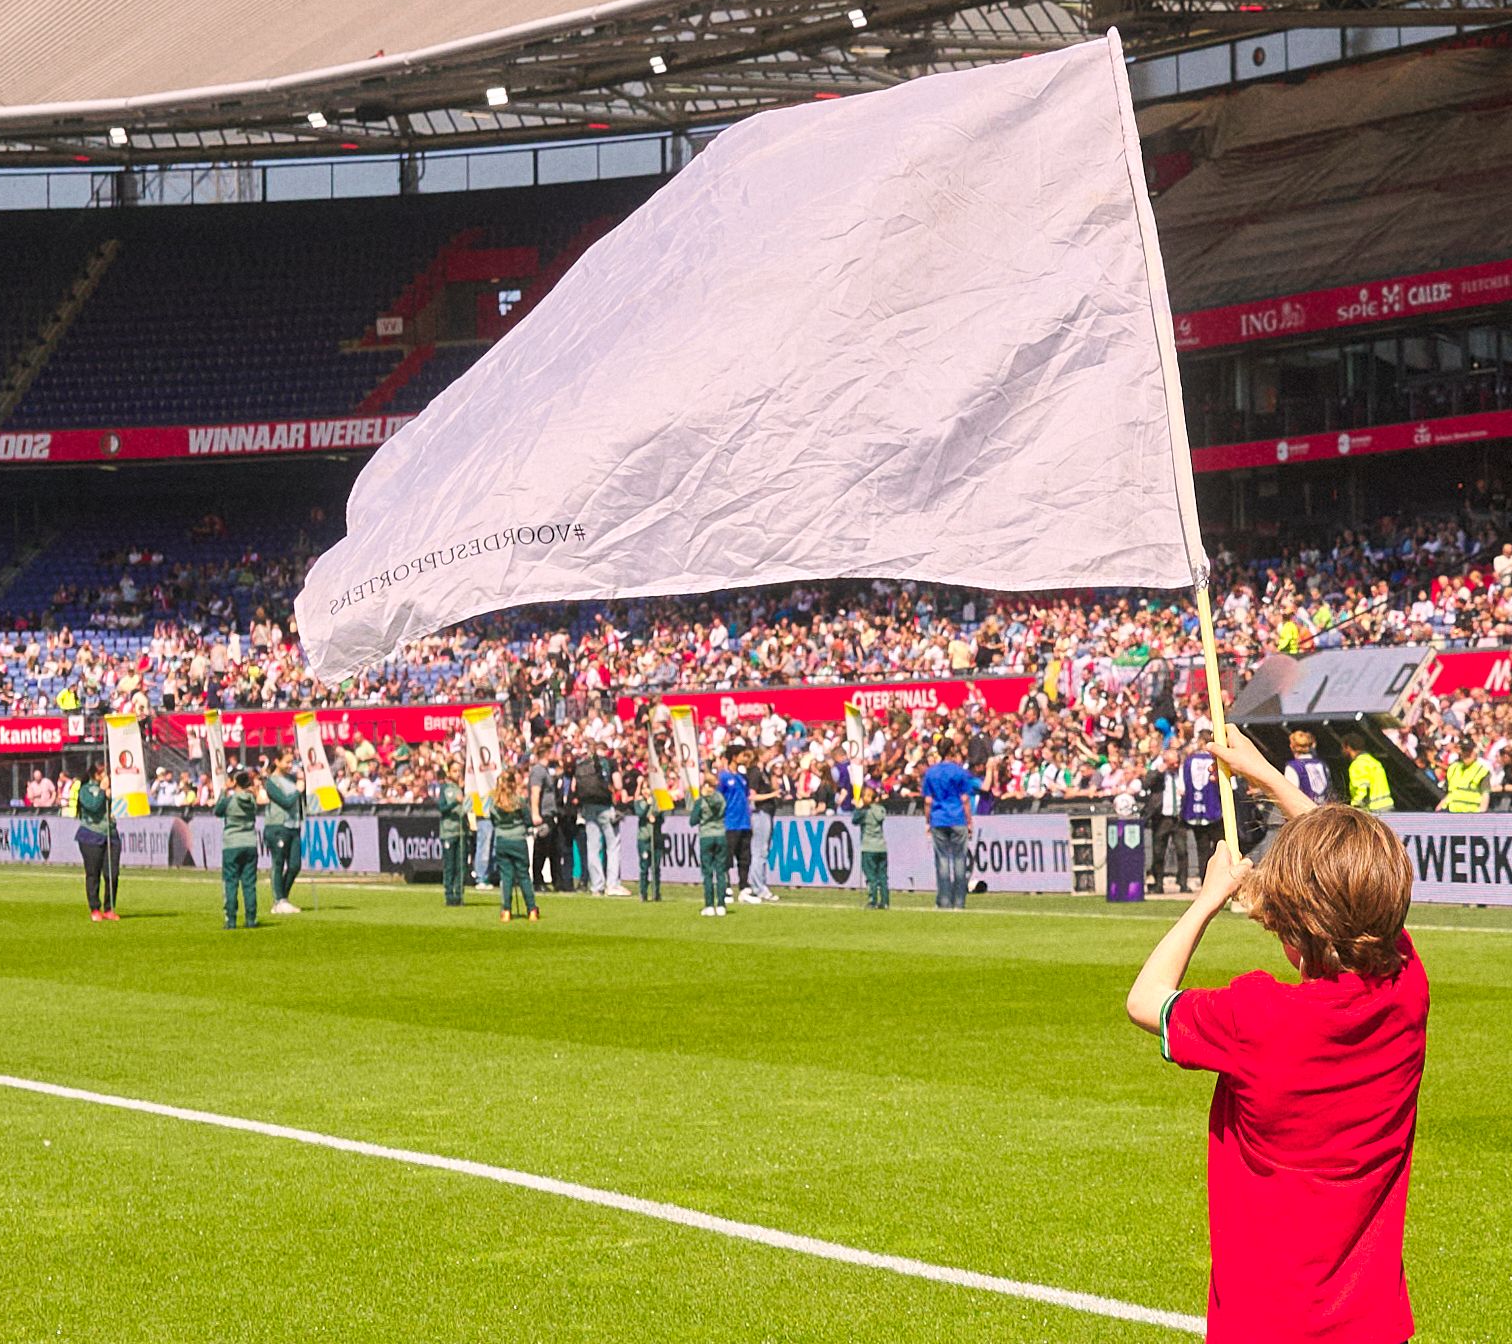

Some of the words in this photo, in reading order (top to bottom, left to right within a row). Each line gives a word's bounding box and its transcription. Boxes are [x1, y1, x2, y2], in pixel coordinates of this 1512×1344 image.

[1240, 310, 1278, 337] ING
[189, 422, 305, 455] WINNAAR
[309, 416, 409, 448] WERELD
[10, 819, 41, 861] MAX
